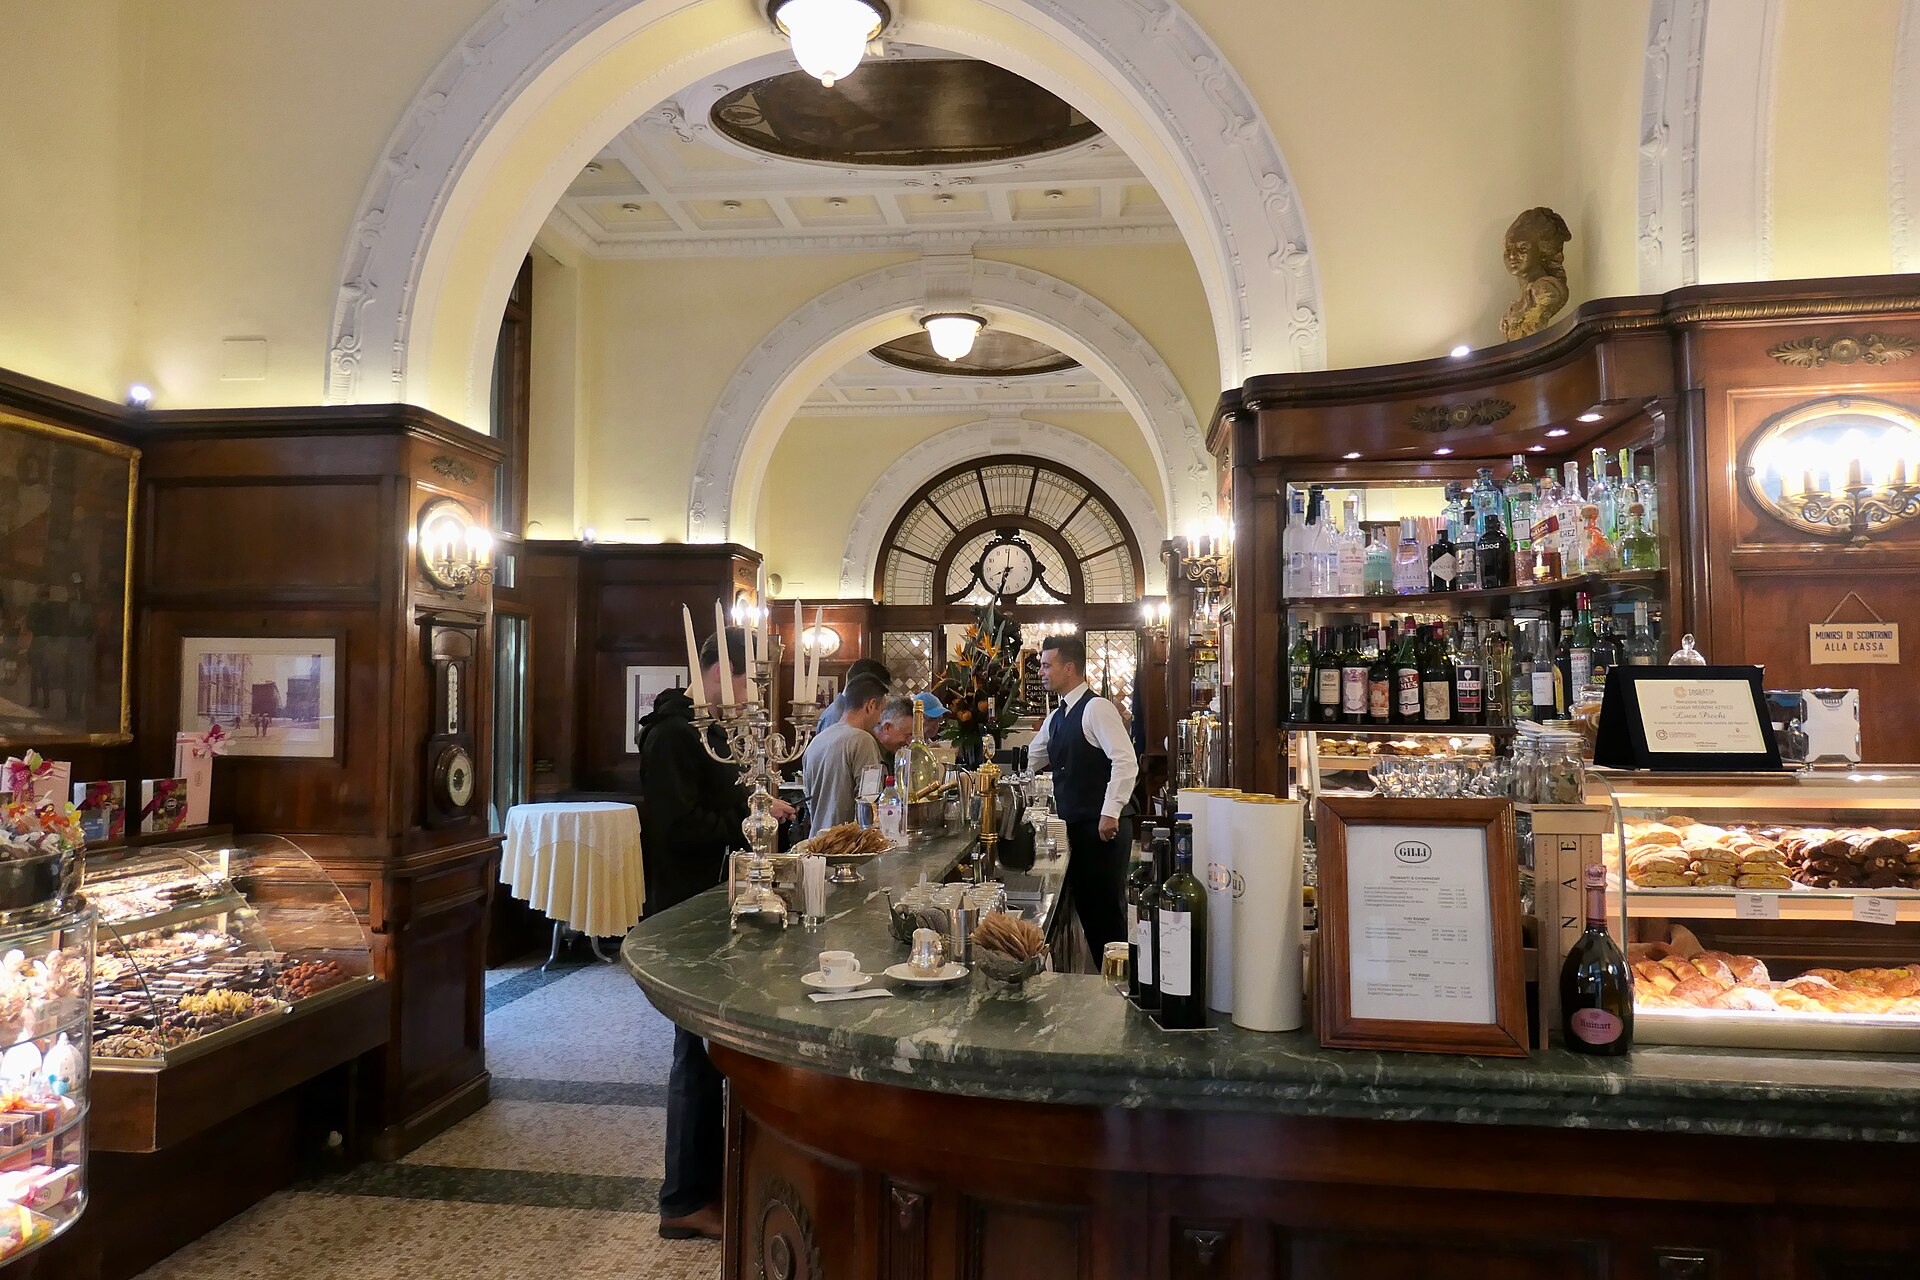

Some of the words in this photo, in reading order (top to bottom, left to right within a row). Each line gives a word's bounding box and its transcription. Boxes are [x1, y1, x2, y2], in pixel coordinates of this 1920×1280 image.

[1815, 631, 1843, 640] MUNIRSI
[1846, 631, 1853, 640] DI
[1857, 630, 1893, 640] SCONTRINO
[1825, 642, 1848, 651] ALLA
[1853, 642, 1885, 651] CASSA
[1672, 710, 1697, 719] Luca
